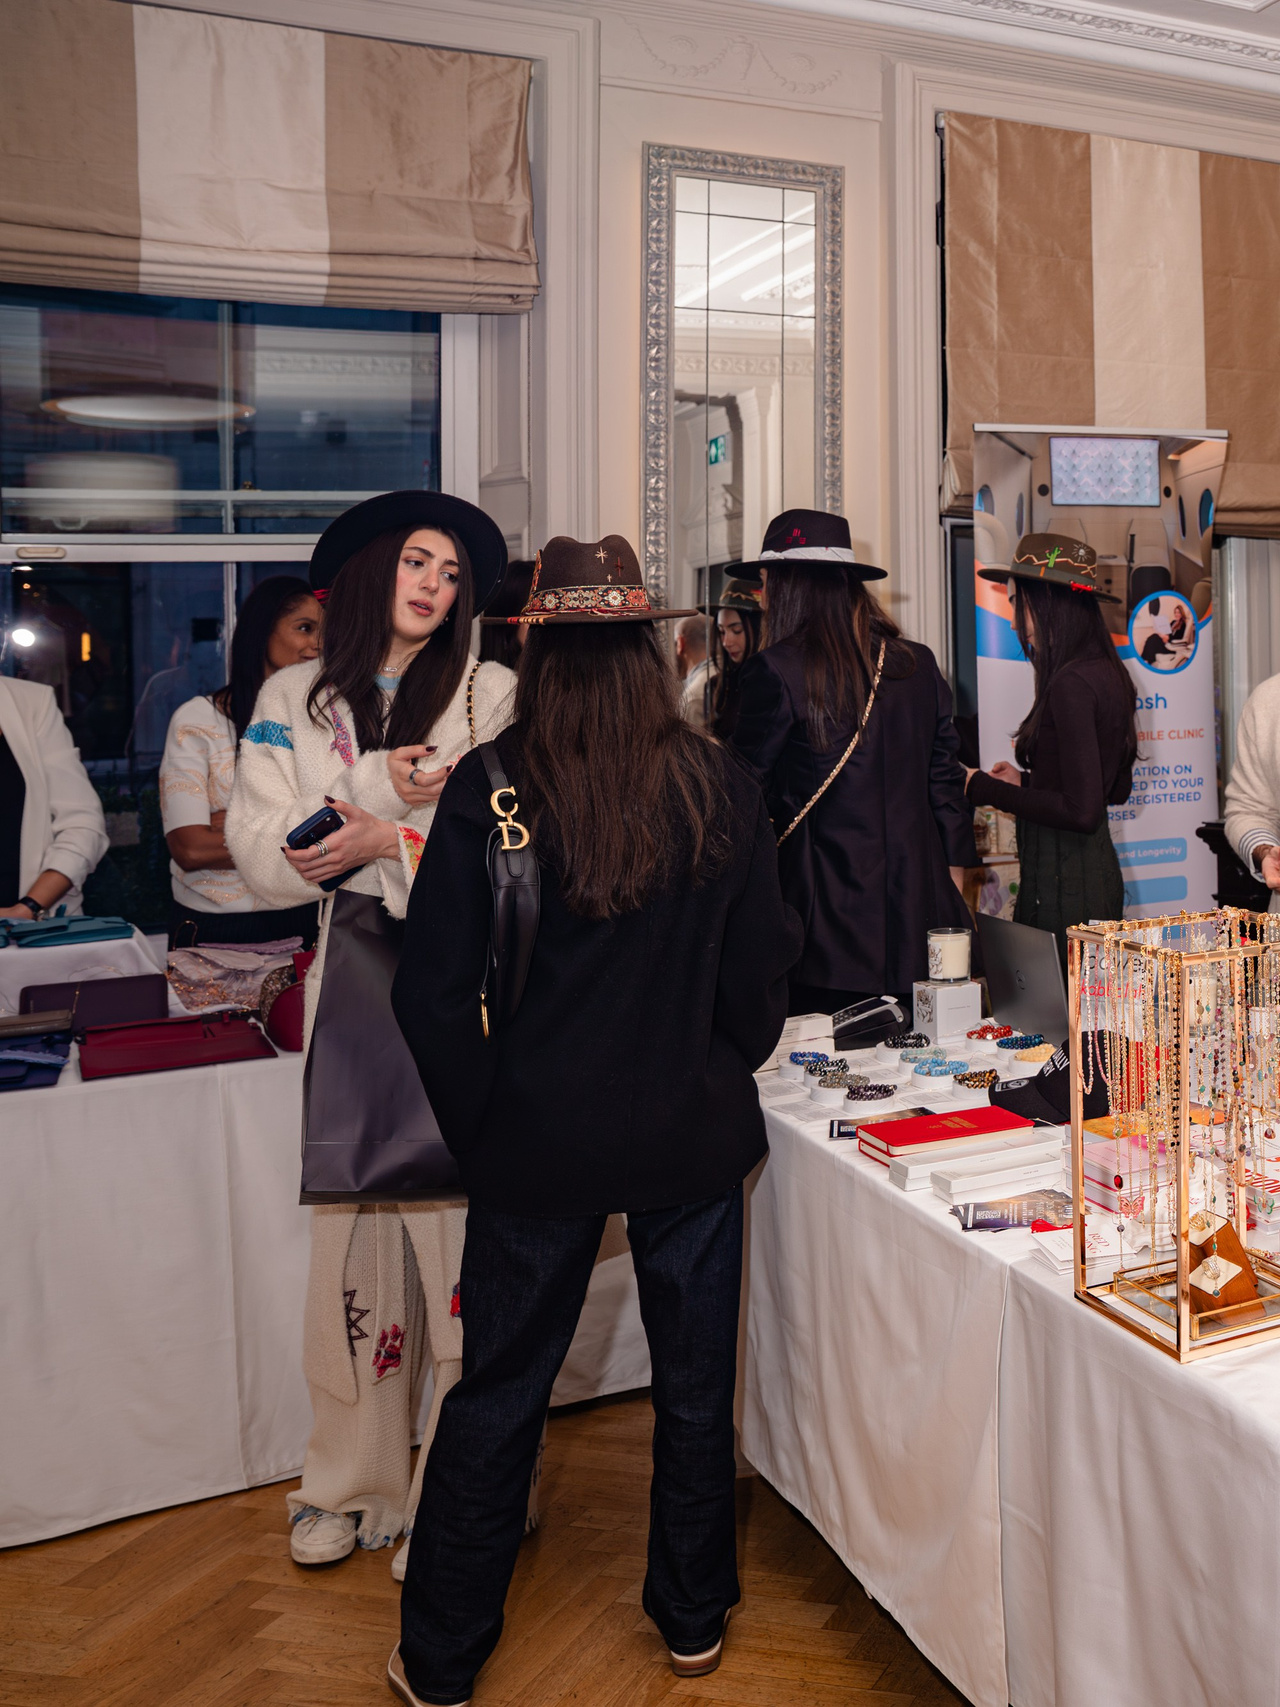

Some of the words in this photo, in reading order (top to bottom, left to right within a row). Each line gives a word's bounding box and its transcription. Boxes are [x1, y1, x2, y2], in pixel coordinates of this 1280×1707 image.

[1136, 693, 1167, 710] ash
[1137, 730, 1164, 742] BILE
[1168, 728, 1205, 740] CLINIC
[1133, 765, 1170, 778] ATION
[1174, 764, 1192, 775] ON
[1132, 779, 1148, 791] ED
[1152, 778, 1168, 790] TO
[1172, 777, 1204, 789] YOUR
[1128, 792, 1202, 806] REGISTERED
[1108, 810, 1136, 822] RSES
[1118, 851, 1135, 859] and
[1137, 846, 1182, 859] Longevity
[1084, 955, 1147, 976] powe
